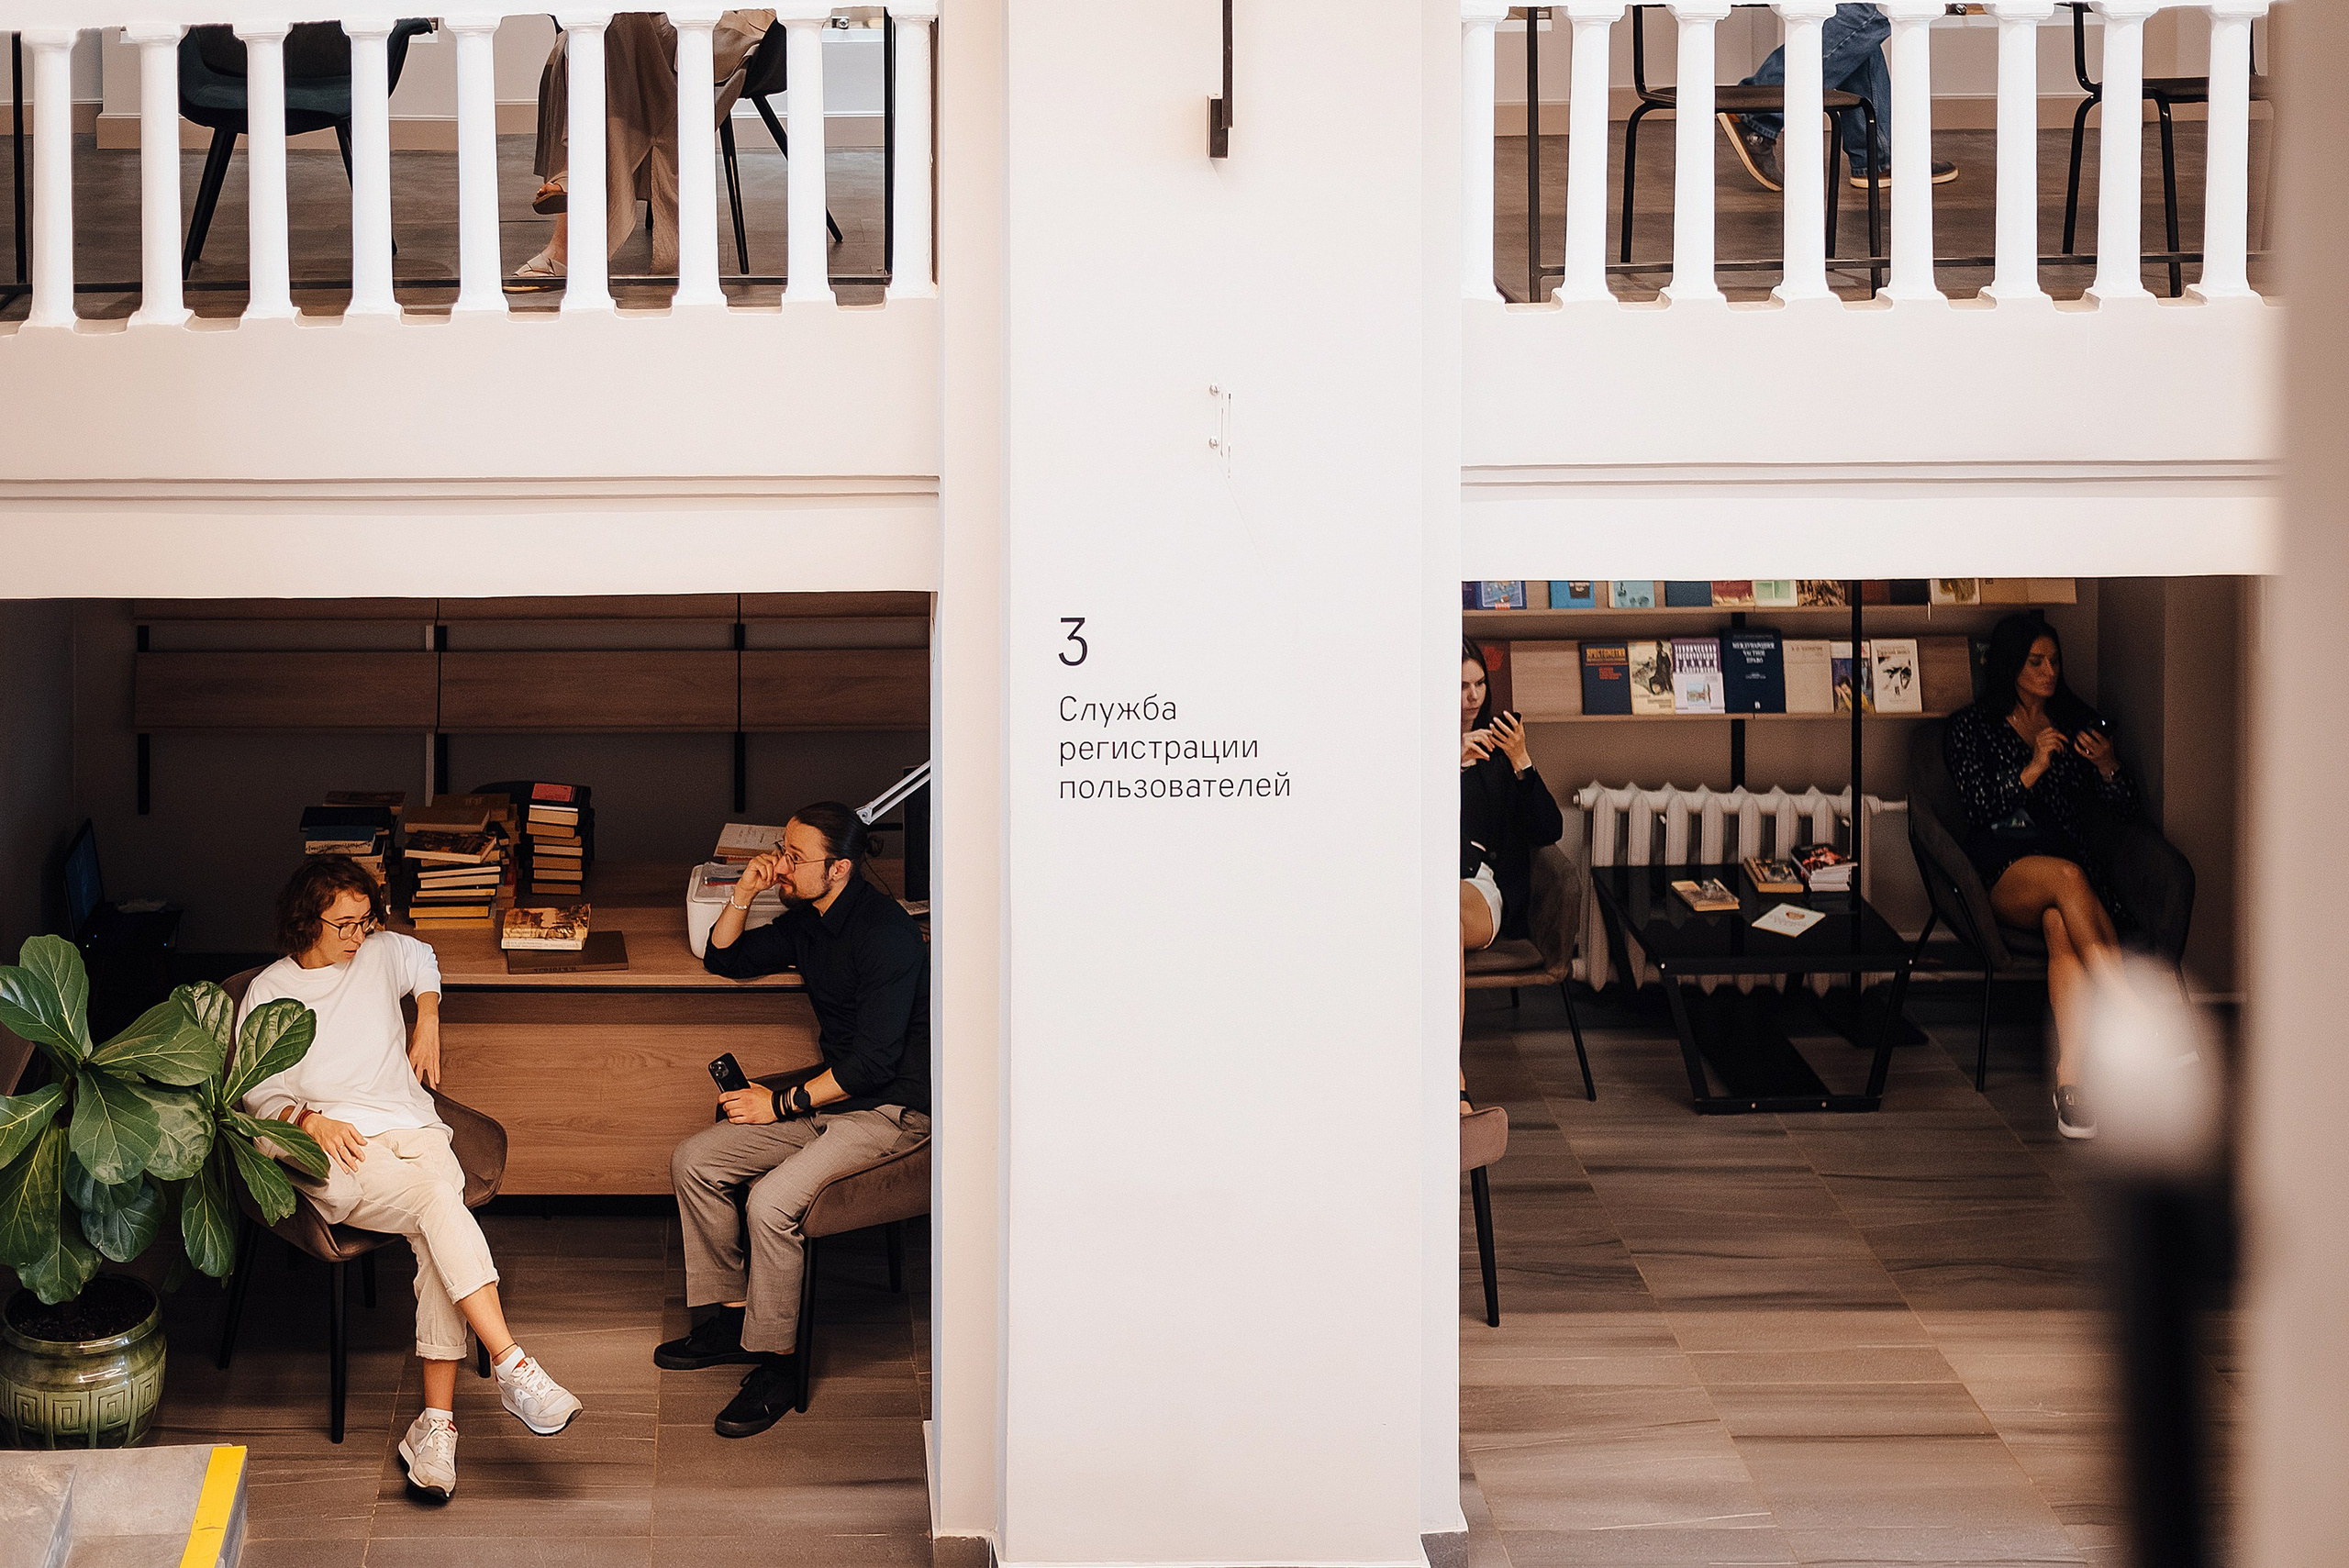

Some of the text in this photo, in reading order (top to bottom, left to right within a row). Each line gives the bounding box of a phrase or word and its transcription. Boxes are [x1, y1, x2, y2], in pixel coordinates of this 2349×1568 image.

[1058, 617, 1088, 667] 3
[1059, 693, 1177, 728] Служба
[1059, 739, 1259, 767] регистрации
[1059, 771, 1291, 799] пользователей
